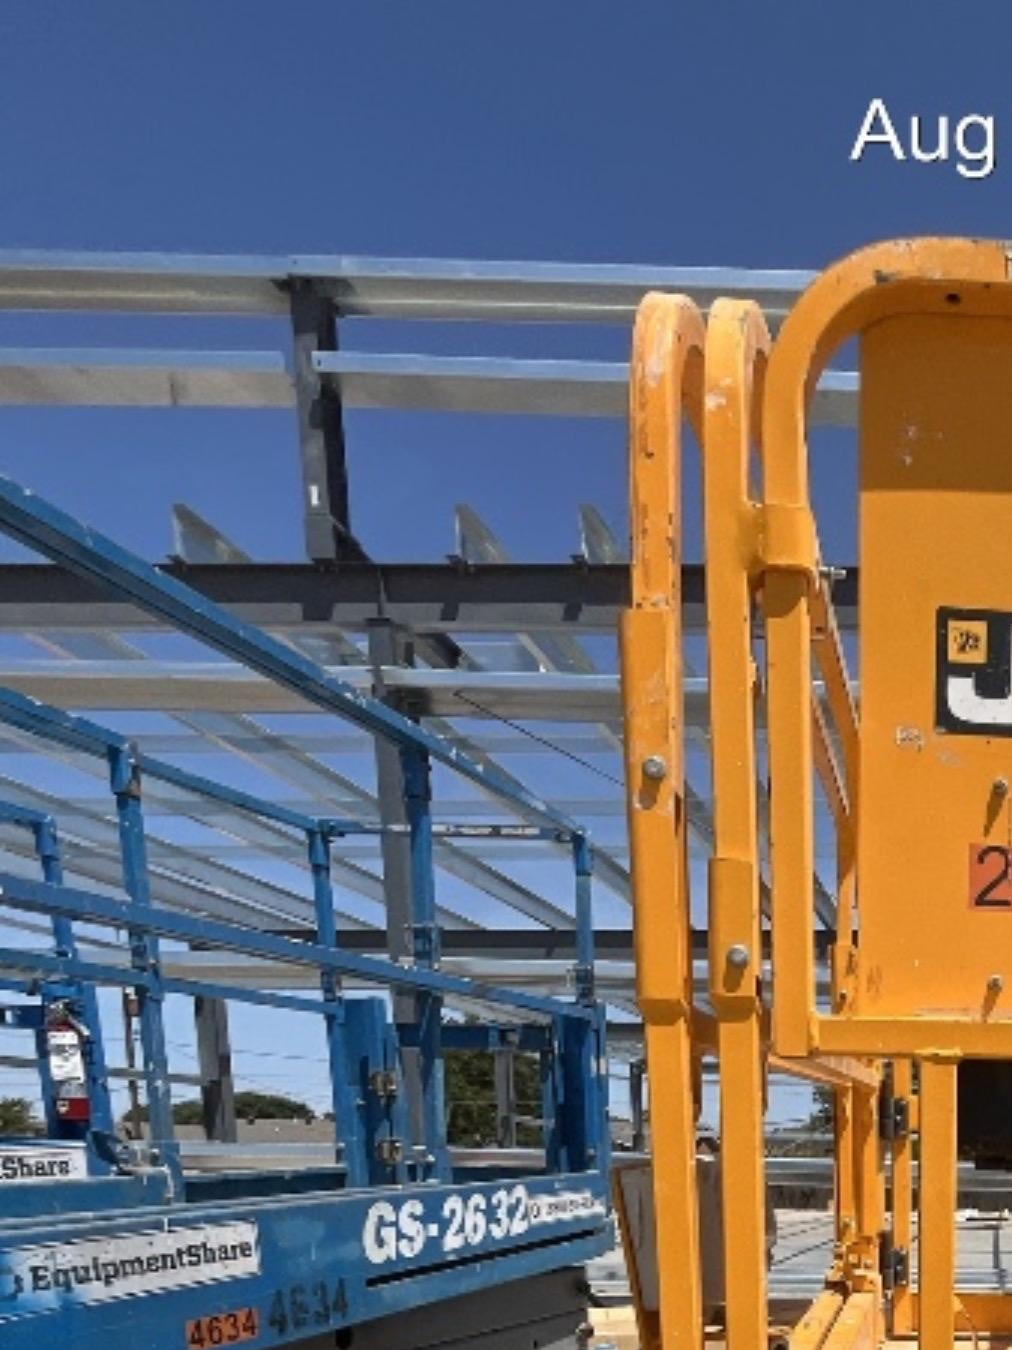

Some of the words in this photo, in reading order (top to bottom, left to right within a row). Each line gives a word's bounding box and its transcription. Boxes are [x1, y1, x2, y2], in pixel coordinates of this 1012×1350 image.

[363, 1184, 529, 1264] GS-2632
[29, 1241, 253, 1293] EquipmentShare
[188, 1307, 258, 1348] 4634
